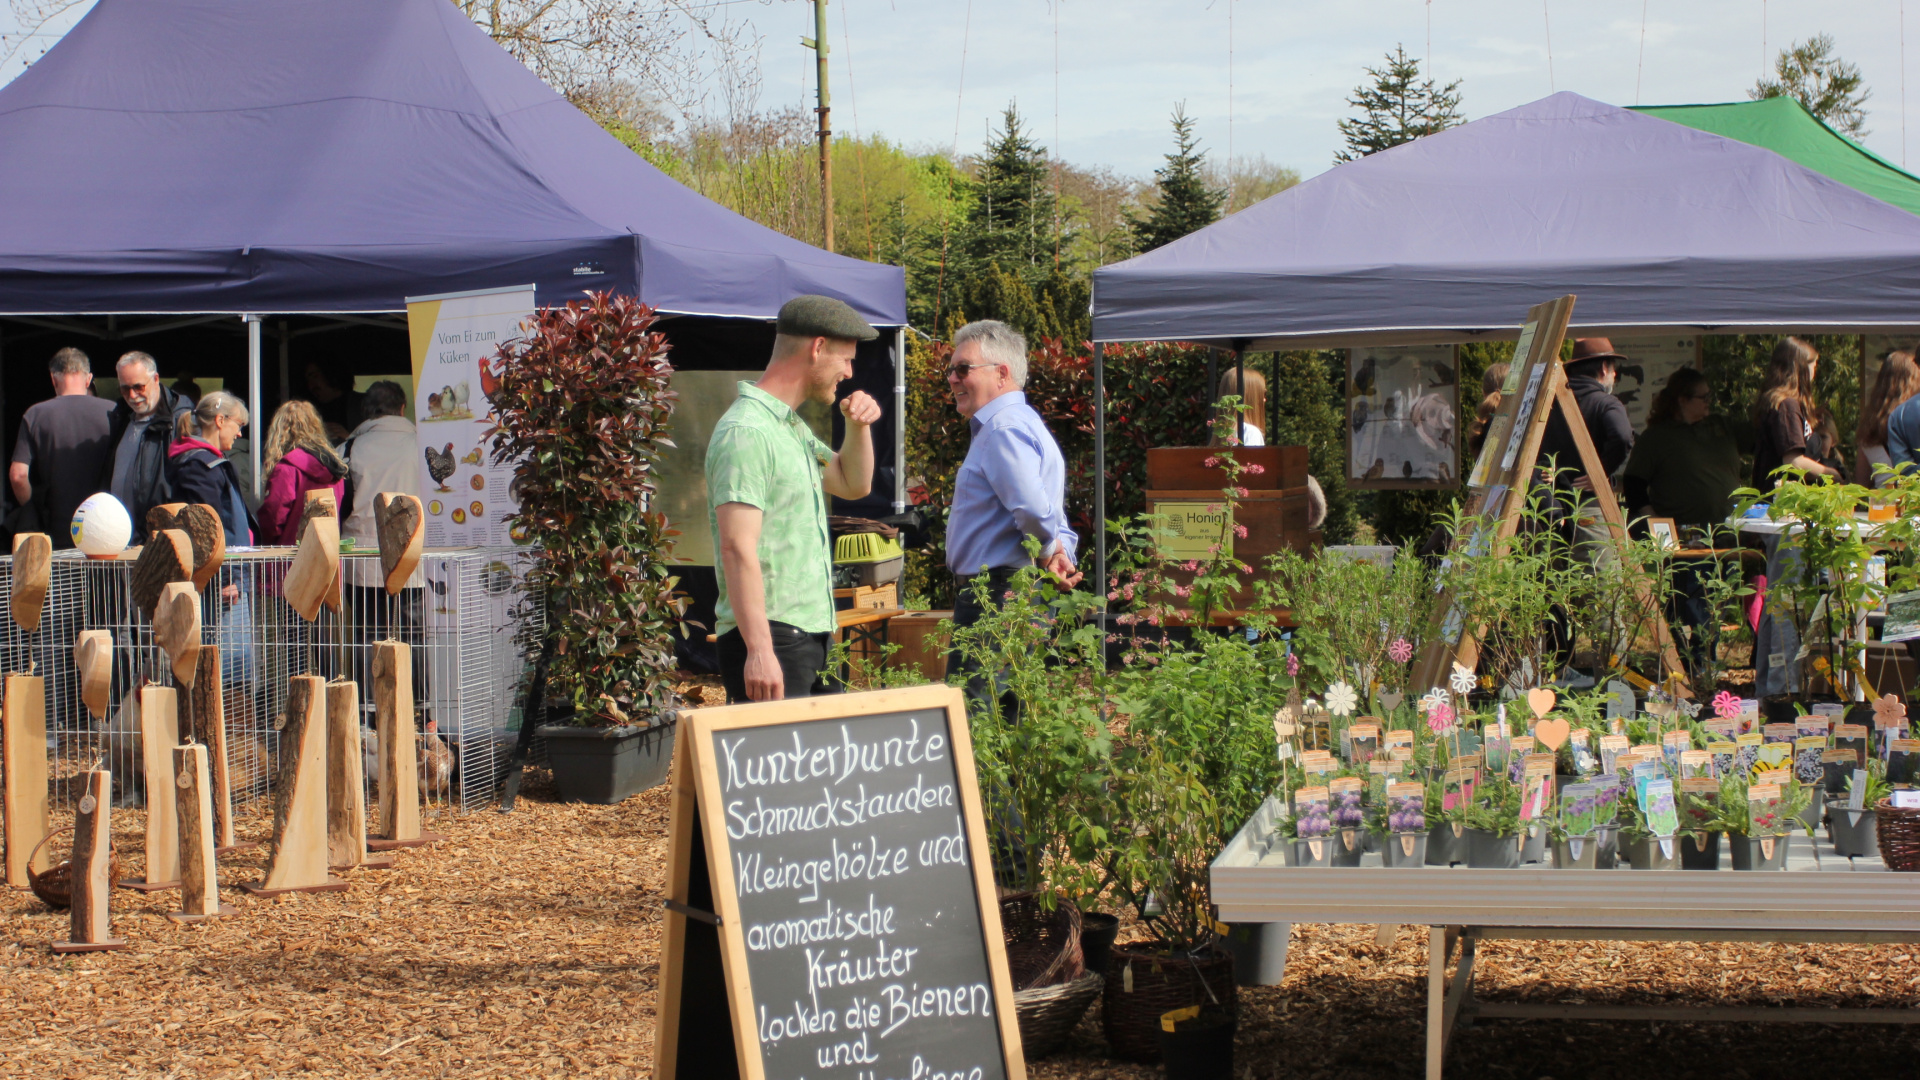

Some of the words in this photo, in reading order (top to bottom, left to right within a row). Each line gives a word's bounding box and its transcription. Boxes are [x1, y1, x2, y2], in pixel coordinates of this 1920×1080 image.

[438, 333, 461, 345] Vom
[464, 330, 472, 342] Ei
[475, 331, 496, 342] zum
[439, 350, 470, 364] Küken
[1187, 512, 1221, 526] Honig
[722, 719, 944, 791] Kunterbunte
[727, 774, 953, 840] Schmuckstauden
[737, 836, 909, 903] Kleingehölze
[920, 816, 965, 867] und
[748, 894, 895, 951] aromatische
[806, 941, 918, 995] Kräuter
[846, 998, 880, 1030] die
[881, 983, 991, 1038] Bienen
[818, 1032, 879, 1069] und
